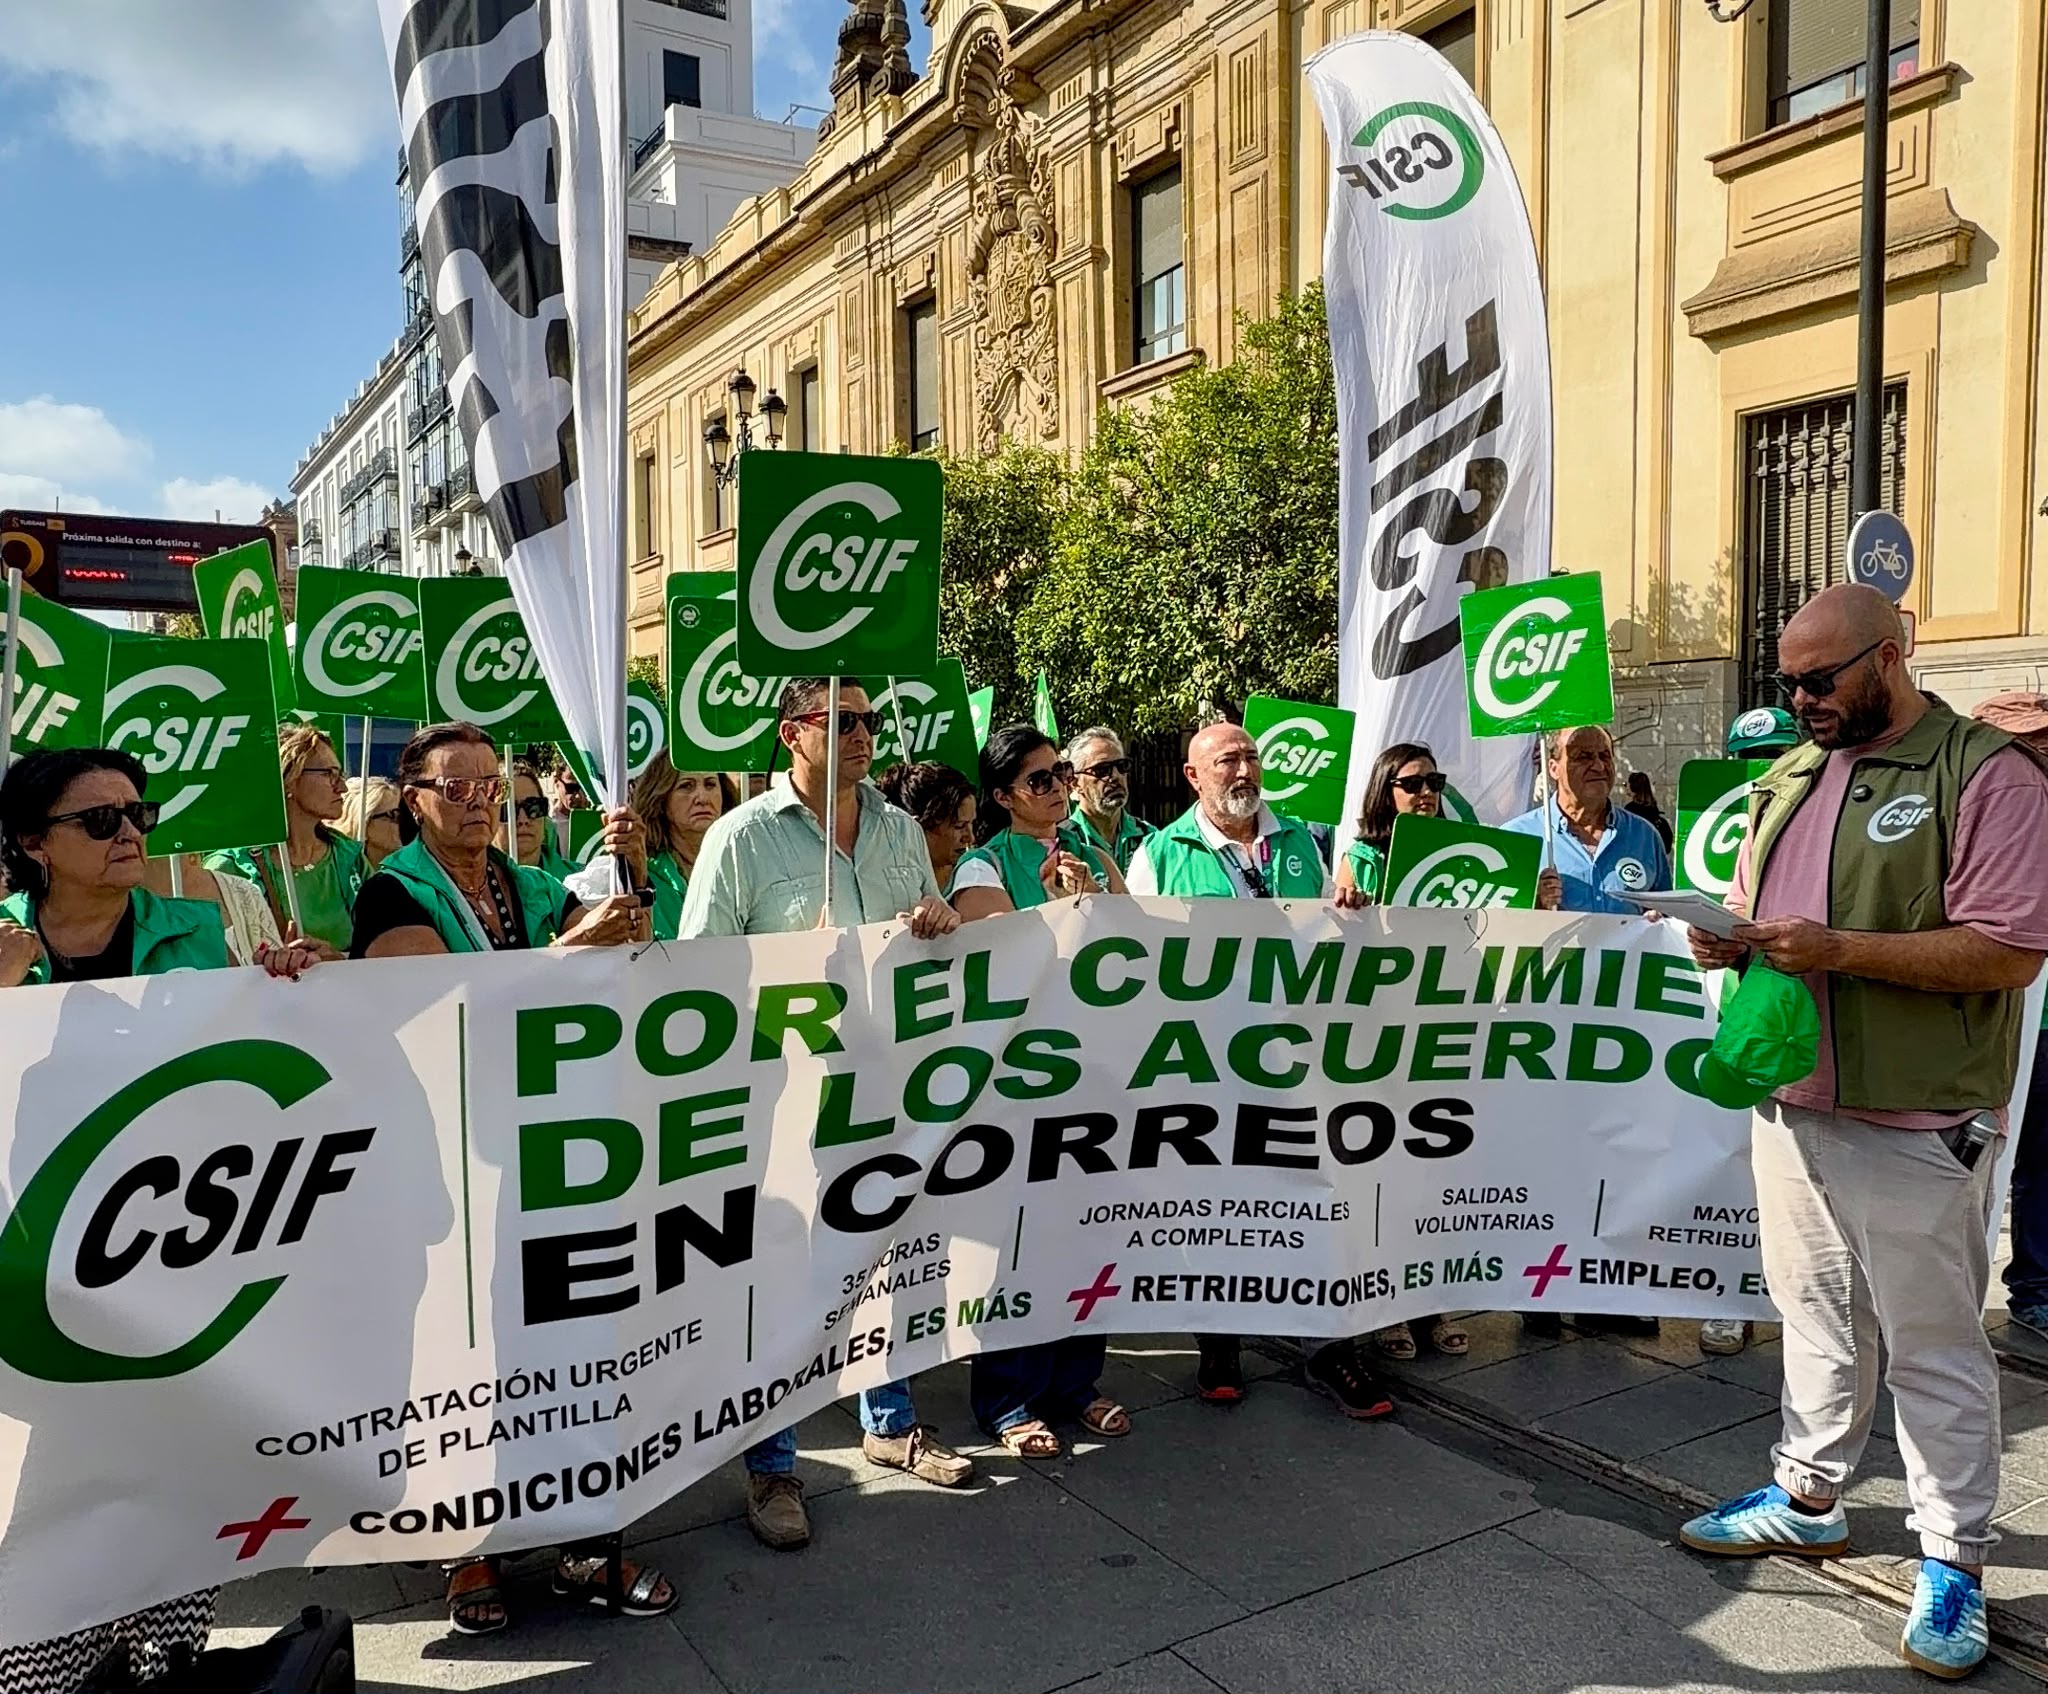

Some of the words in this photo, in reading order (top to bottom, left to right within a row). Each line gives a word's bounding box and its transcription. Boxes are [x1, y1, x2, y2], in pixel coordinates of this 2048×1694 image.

[62, 532, 103, 543] Próxima
[105, 535, 134, 544] salida
[136, 537, 152, 545] con
[155, 537, 190, 548] destino
[784, 532, 919, 592] CSIF
[329, 622, 423, 664] CSIF
[1495, 628, 1588, 679] CSIF
[105, 715, 250, 774] CSIF
[1262, 741, 1338, 777] CSIF
[1881, 807, 1934, 827] CSIF
[516, 981, 848, 1097] POR
[894, 950, 1030, 1043] EL
[1070, 937, 1723, 1023] CUMPLIMIE
[519, 1086, 750, 1212] DE
[814, 1029, 1082, 1148] LOS
[75, 1127, 377, 1288] CSIF
[522, 1184, 756, 1326] EN
[821, 1097, 1475, 1233] CORREOS
[1079, 1199, 1212, 1225] JORNADAS
[1220, 1200, 1350, 1222] PARCIALES
[1415, 1213, 1554, 1235] VOLUNTARIAS
[1442, 1186, 1528, 1206] SALIDAS
[842, 1269, 866, 1295] 35
[867, 1232, 941, 1278] HORAS
[1127, 1230, 1145, 1248] A
[1151, 1228, 1305, 1249] COMPLETAS
[1648, 1225, 1761, 1249] RETRIBU
[824, 1258, 952, 1331] SEMANALES
[1131, 1268, 1396, 1308] RETRIBUCIONES,
[1404, 1261, 1434, 1290] ES
[1443, 1250, 1503, 1285] MÁS
[1579, 1258, 1725, 1297] EMPLEO,
[255, 1369, 557, 1458] CONTRATACIÓN
[570, 1319, 703, 1389] URGENTE
[349, 1422, 682, 1535] CONDICIONES
[694, 1326, 895, 1444] LABORALES,
[906, 1306, 946, 1344] ES
[957, 1287, 1032, 1328] MÁS
[378, 1439, 427, 1479] DE
[440, 1392, 633, 1459] PLANTILLA
